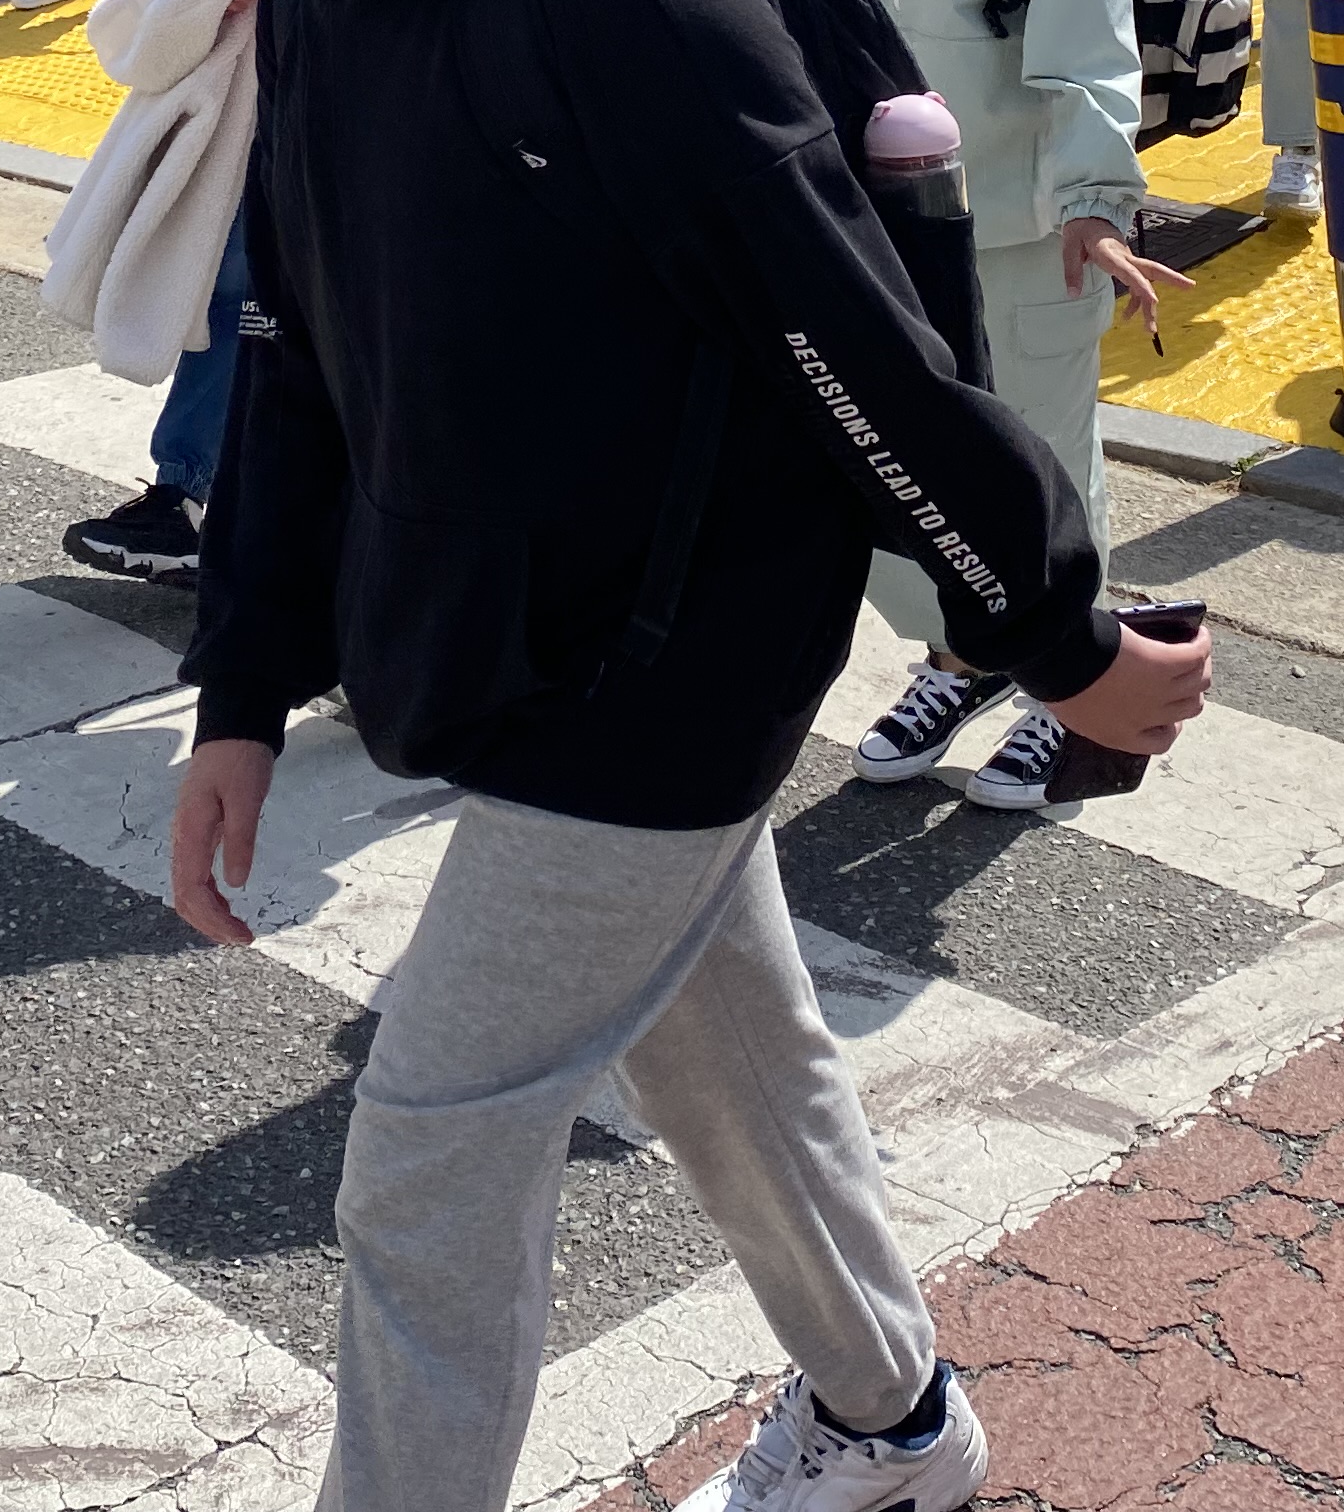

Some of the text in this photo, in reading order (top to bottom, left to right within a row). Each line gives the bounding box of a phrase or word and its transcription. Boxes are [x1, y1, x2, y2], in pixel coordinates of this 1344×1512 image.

[784, 332, 1007, 613] DECISIONS LEAD TO RESULTS
